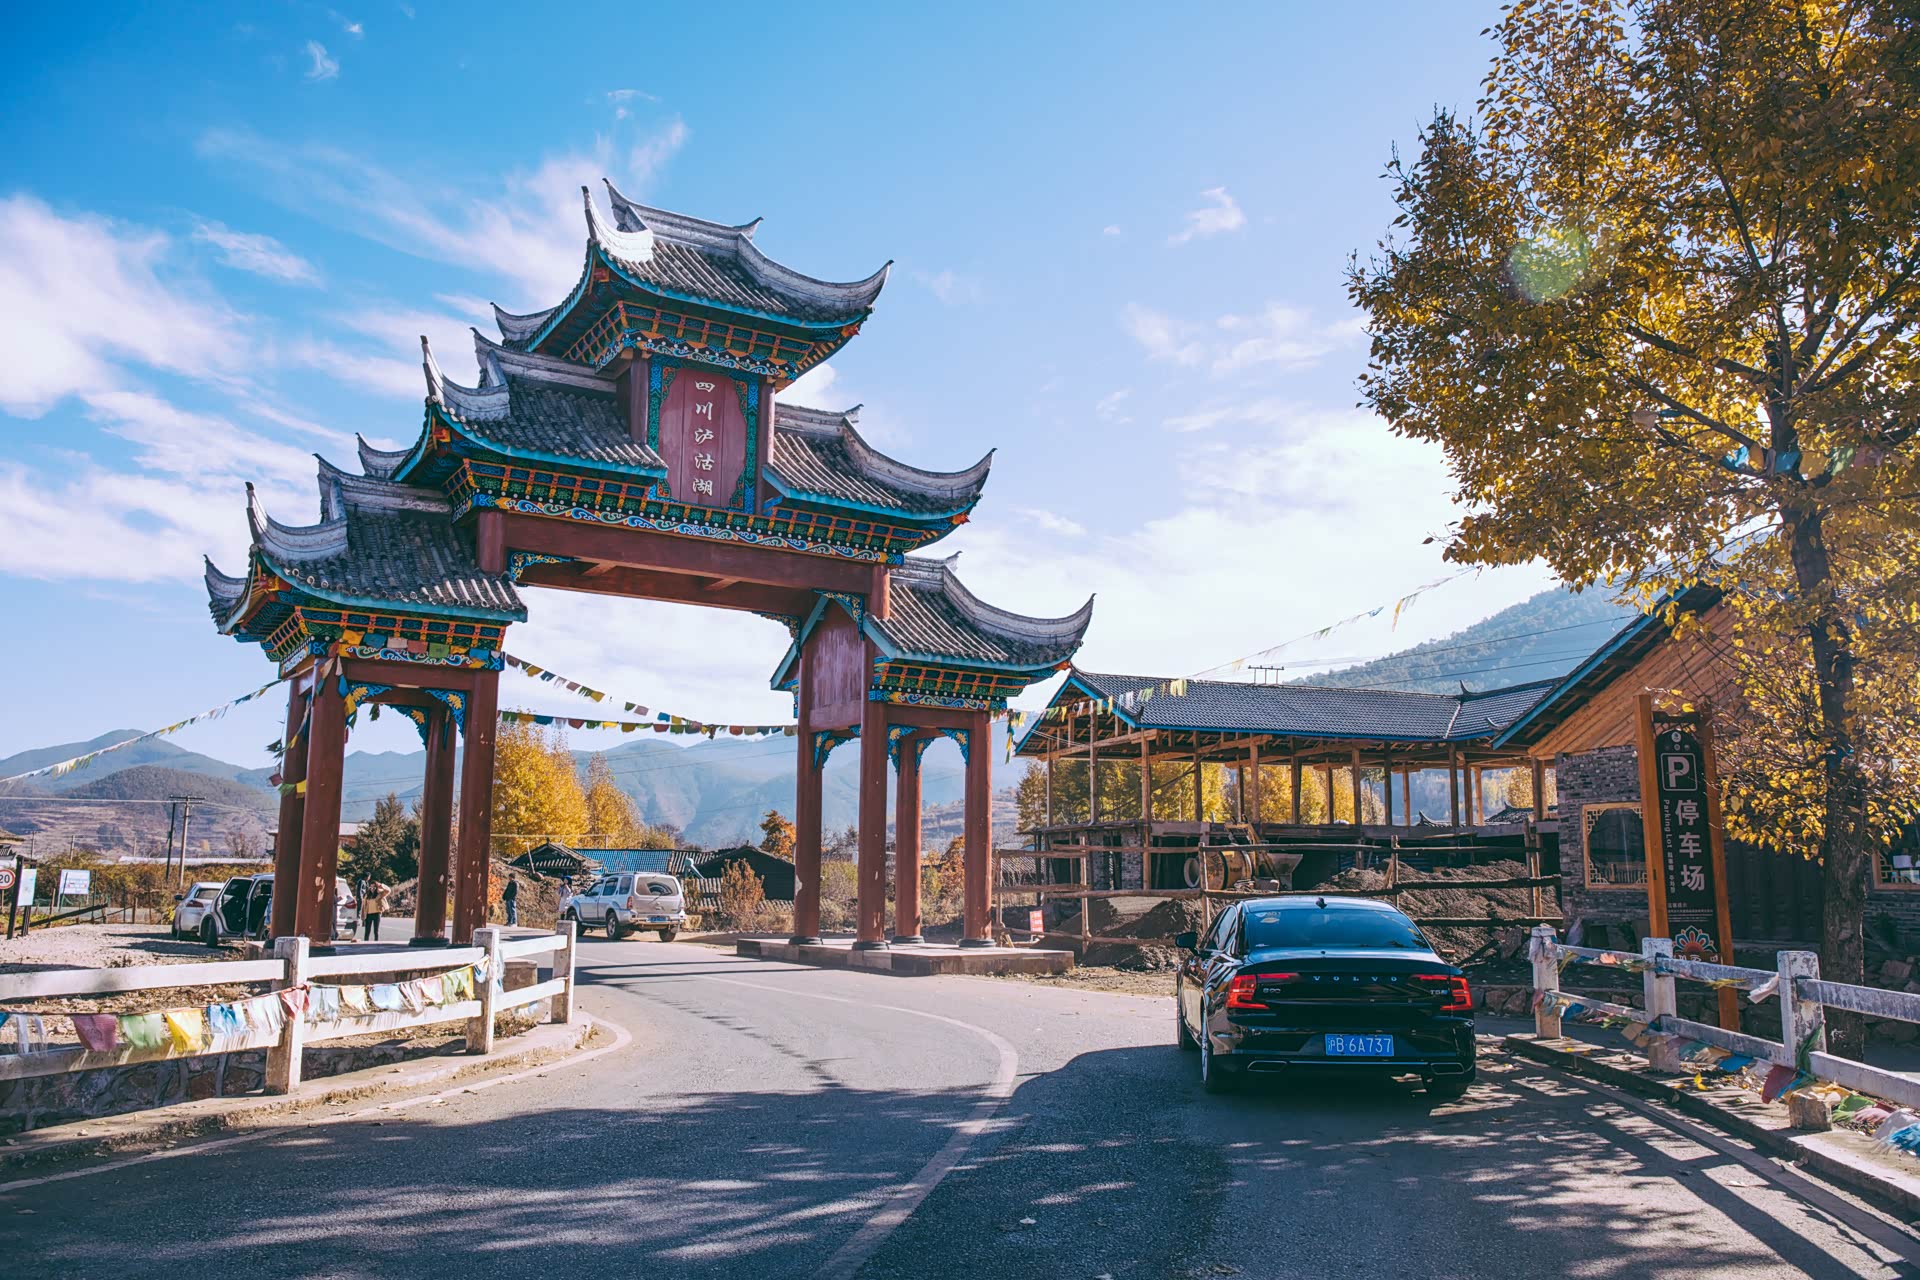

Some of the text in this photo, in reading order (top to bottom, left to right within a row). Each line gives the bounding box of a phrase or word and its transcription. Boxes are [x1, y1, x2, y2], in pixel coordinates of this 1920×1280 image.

[692, 380, 716, 496] 四川泸沽湖
[1667, 756, 1690, 788] P
[1663, 799, 1672, 832] Parking
[1675, 799, 1705, 891] 停车场
